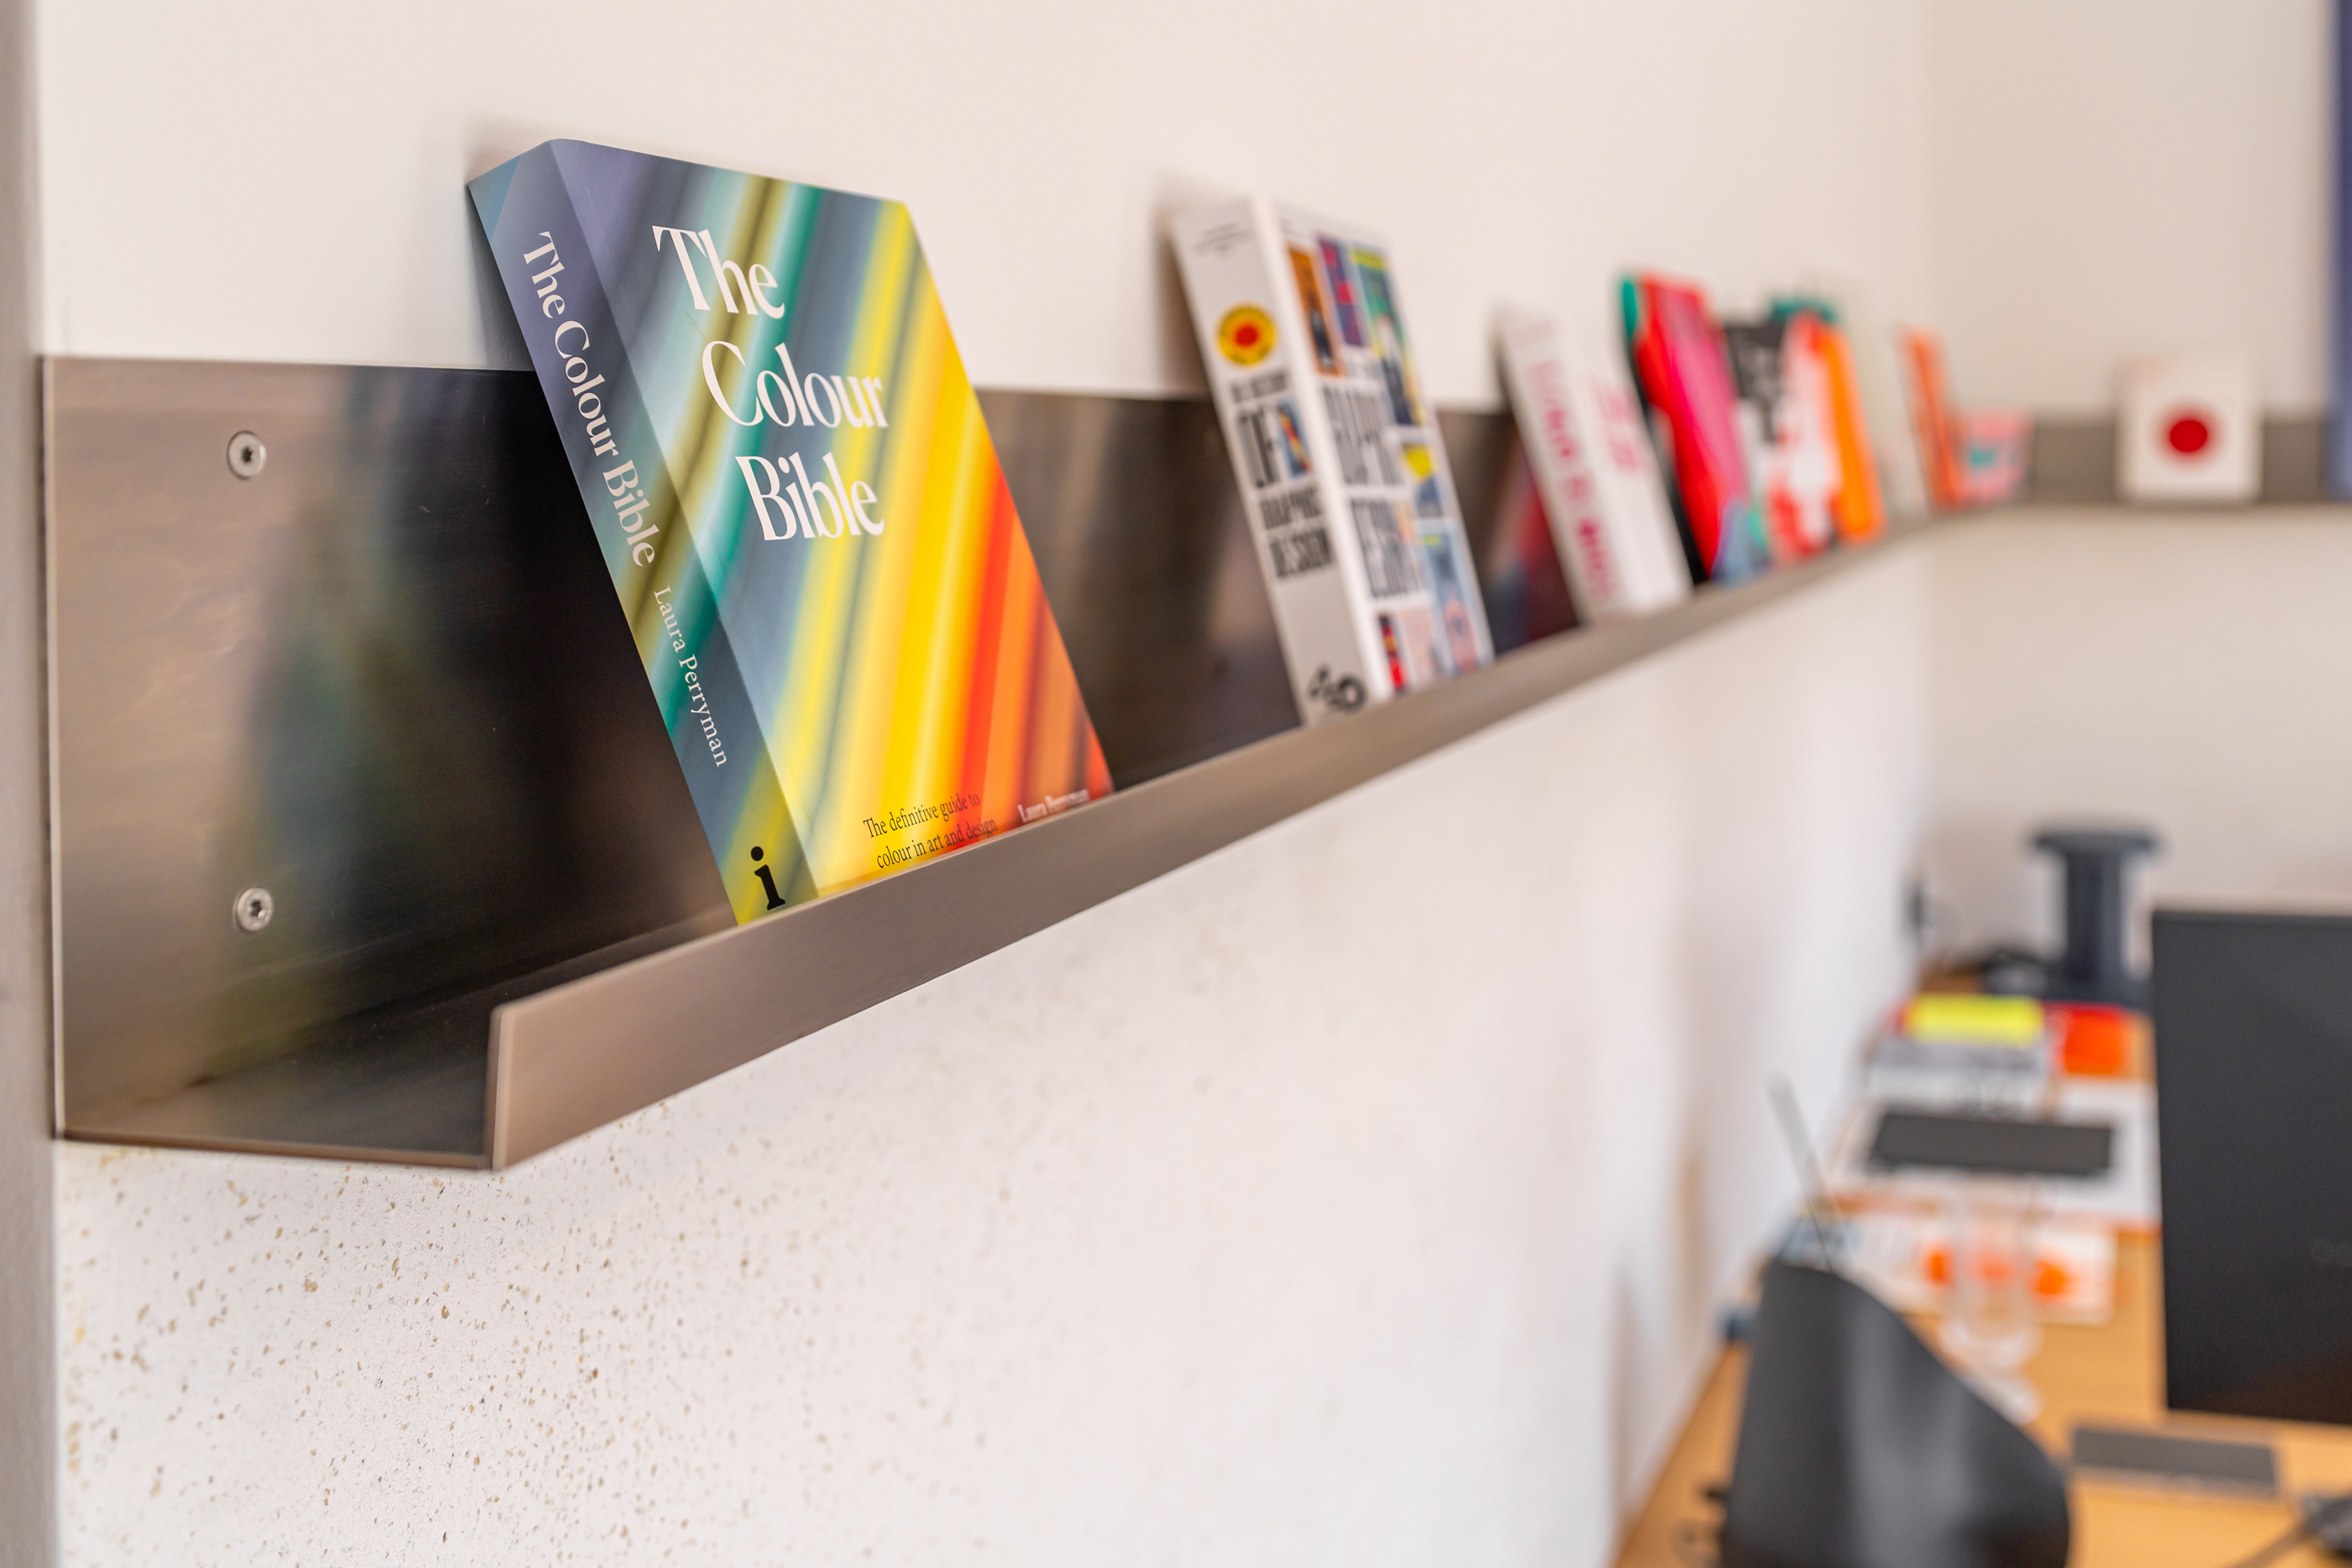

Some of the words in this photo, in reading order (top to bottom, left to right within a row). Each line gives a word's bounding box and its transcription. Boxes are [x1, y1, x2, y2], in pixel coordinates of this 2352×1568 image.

[652, 225, 785, 319] The
[523, 231, 565, 318] The
[554, 320, 619, 456] Colour
[602, 459, 660, 567] Bible
[702, 341, 888, 428] Colour
[735, 451, 885, 541] Bible
[654, 585, 686, 653] Laura
[679, 653, 728, 768] Perryman
[863, 816, 888, 838] The
[889, 804, 939, 832] definitive
[939, 793, 968, 821] guide
[968, 792, 980, 809] to
[876, 845, 912, 868] colour
[911, 839, 927, 857] in
[928, 833, 944, 852] art
[946, 823, 965, 847] and
[966, 817, 998, 838] design
